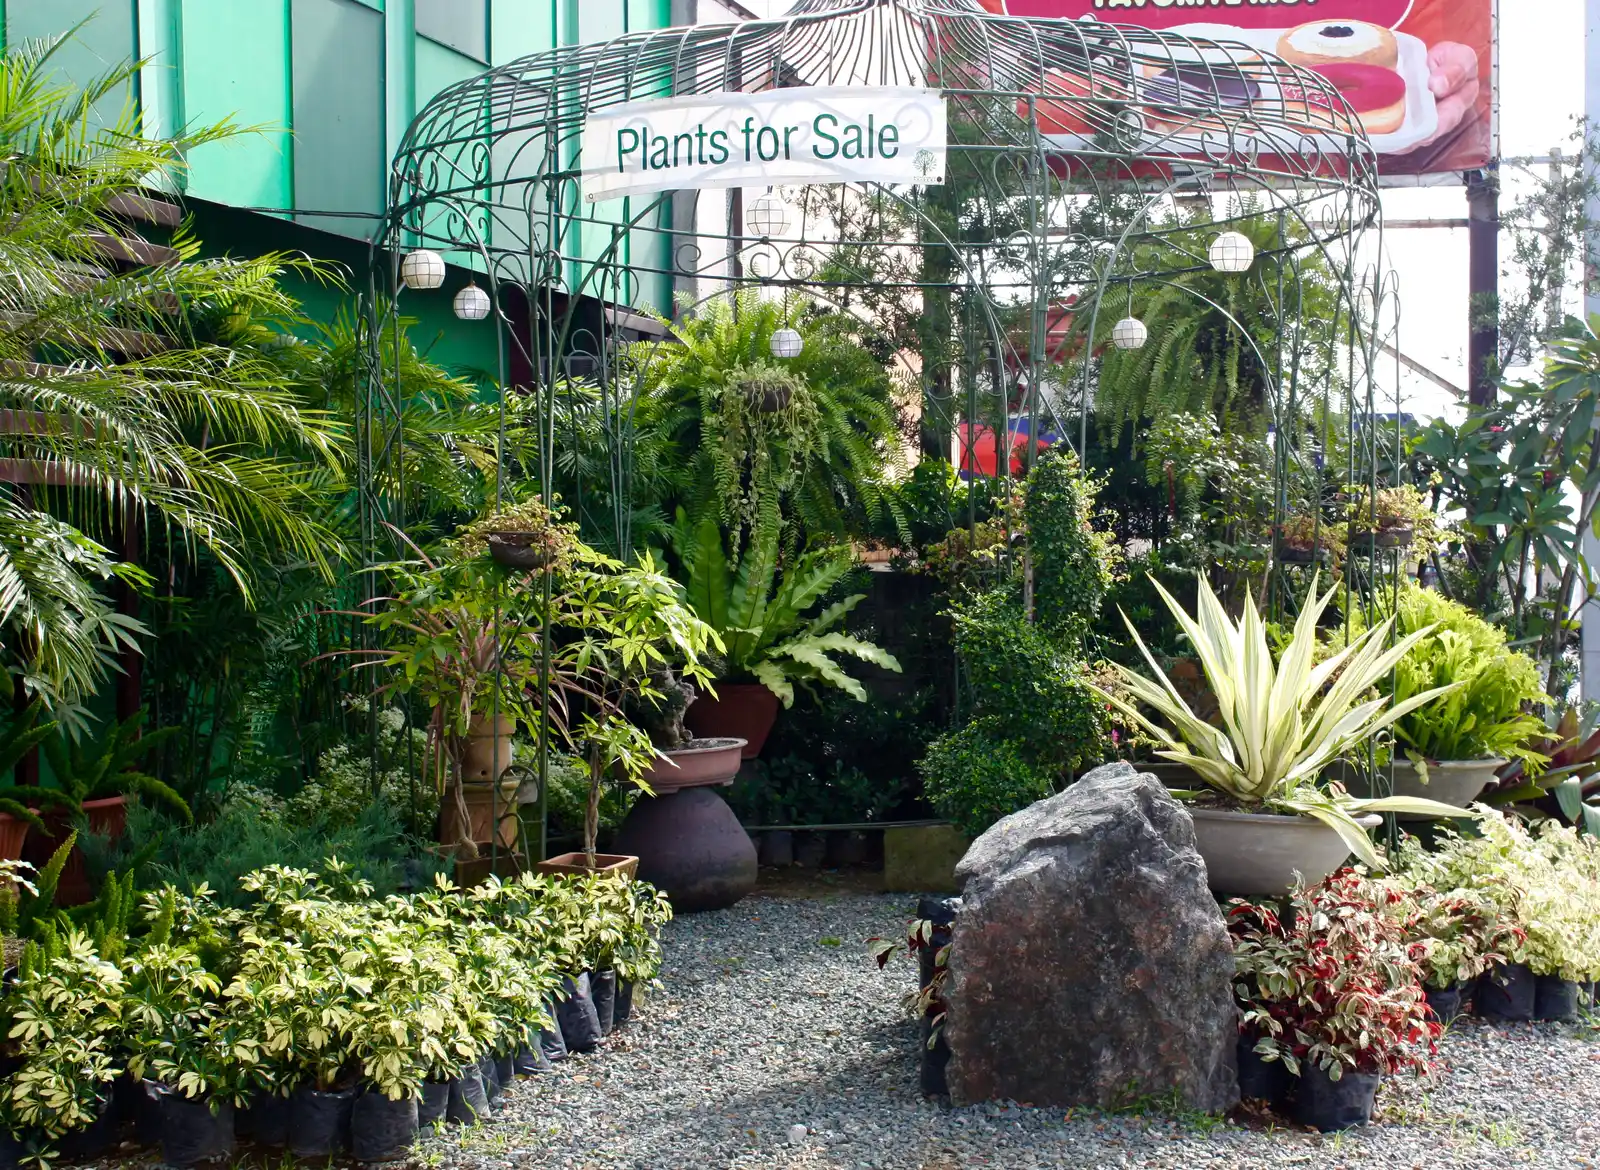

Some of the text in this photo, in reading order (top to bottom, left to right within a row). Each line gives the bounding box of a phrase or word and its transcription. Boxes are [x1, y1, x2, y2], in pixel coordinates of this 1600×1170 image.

[617, 113, 899, 173] Plants for Sale
